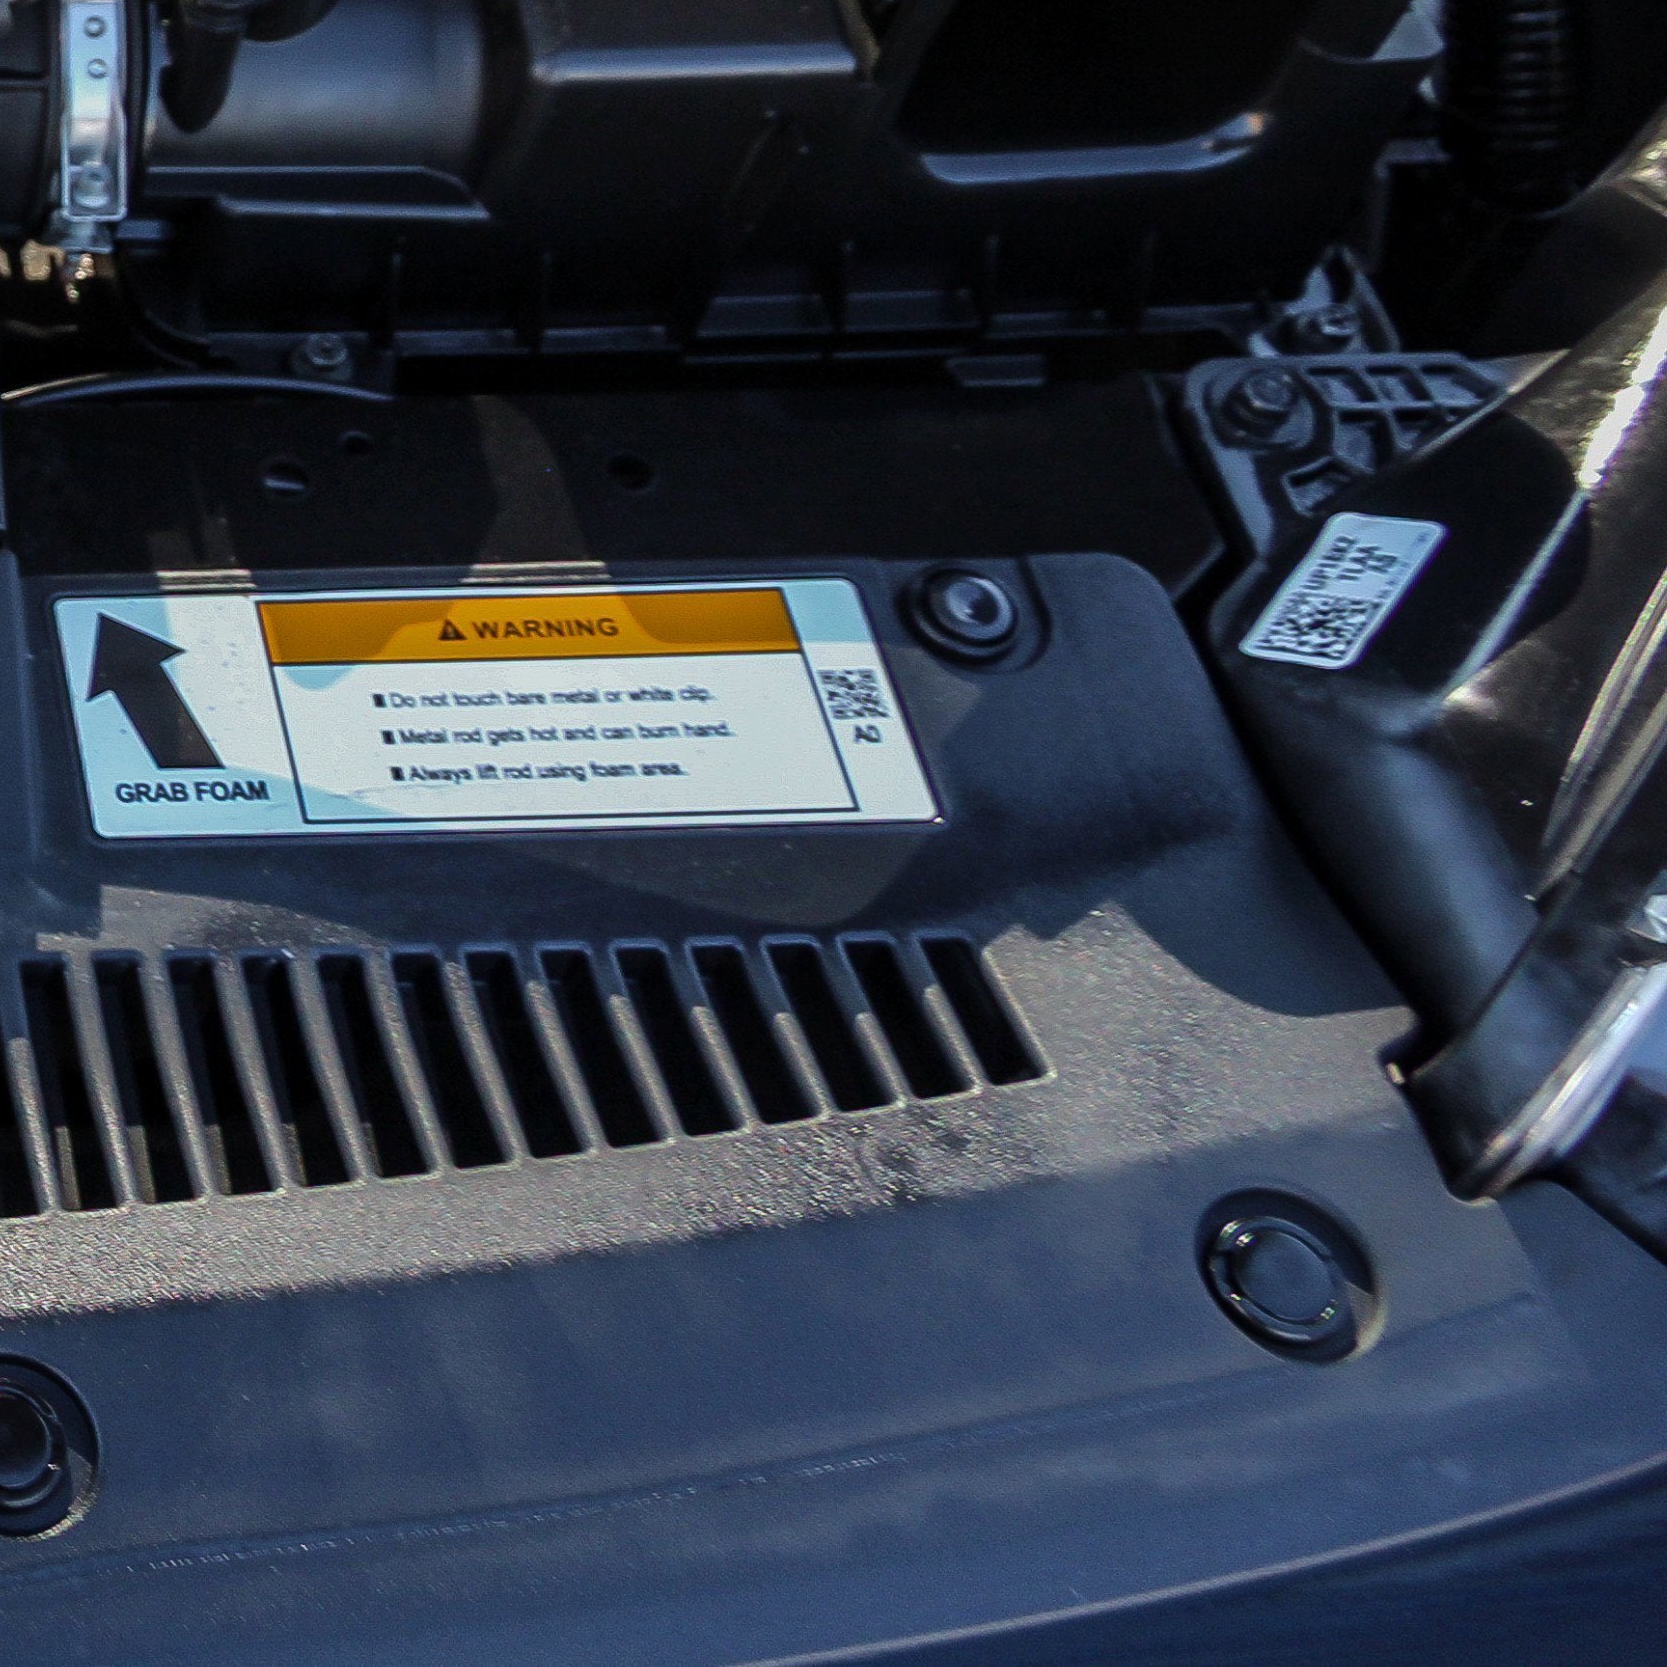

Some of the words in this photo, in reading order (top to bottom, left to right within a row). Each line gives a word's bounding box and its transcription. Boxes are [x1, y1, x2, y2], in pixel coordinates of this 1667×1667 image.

[471, 617, 619, 639] WARNING
[388, 691, 416, 708] Do
[419, 691, 450, 707] not
[451, 689, 503, 707] touch
[504, 688, 547, 705] bare
[550, 686, 599, 704] metal
[603, 690, 622, 703] or
[628, 685, 674, 703] white
[397, 727, 449, 744] Metal
[452, 727, 483, 743] rod
[486, 727, 526, 747] gets
[528, 725, 559, 742] hot
[563, 723, 598, 741] and
[601, 726, 635, 740] can
[635, 722, 680, 739] burn
[680, 719, 736, 738] hand.
[410, 765, 474, 784] Always
[475, 763, 500, 780] lift
[502, 762, 534, 779] rod
[535, 760, 587, 782] using
[588, 760, 638, 778] foam
[639, 761, 688, 777] area.
[115, 782, 189, 803] GRAB
[194, 780, 271, 801] FOAM
